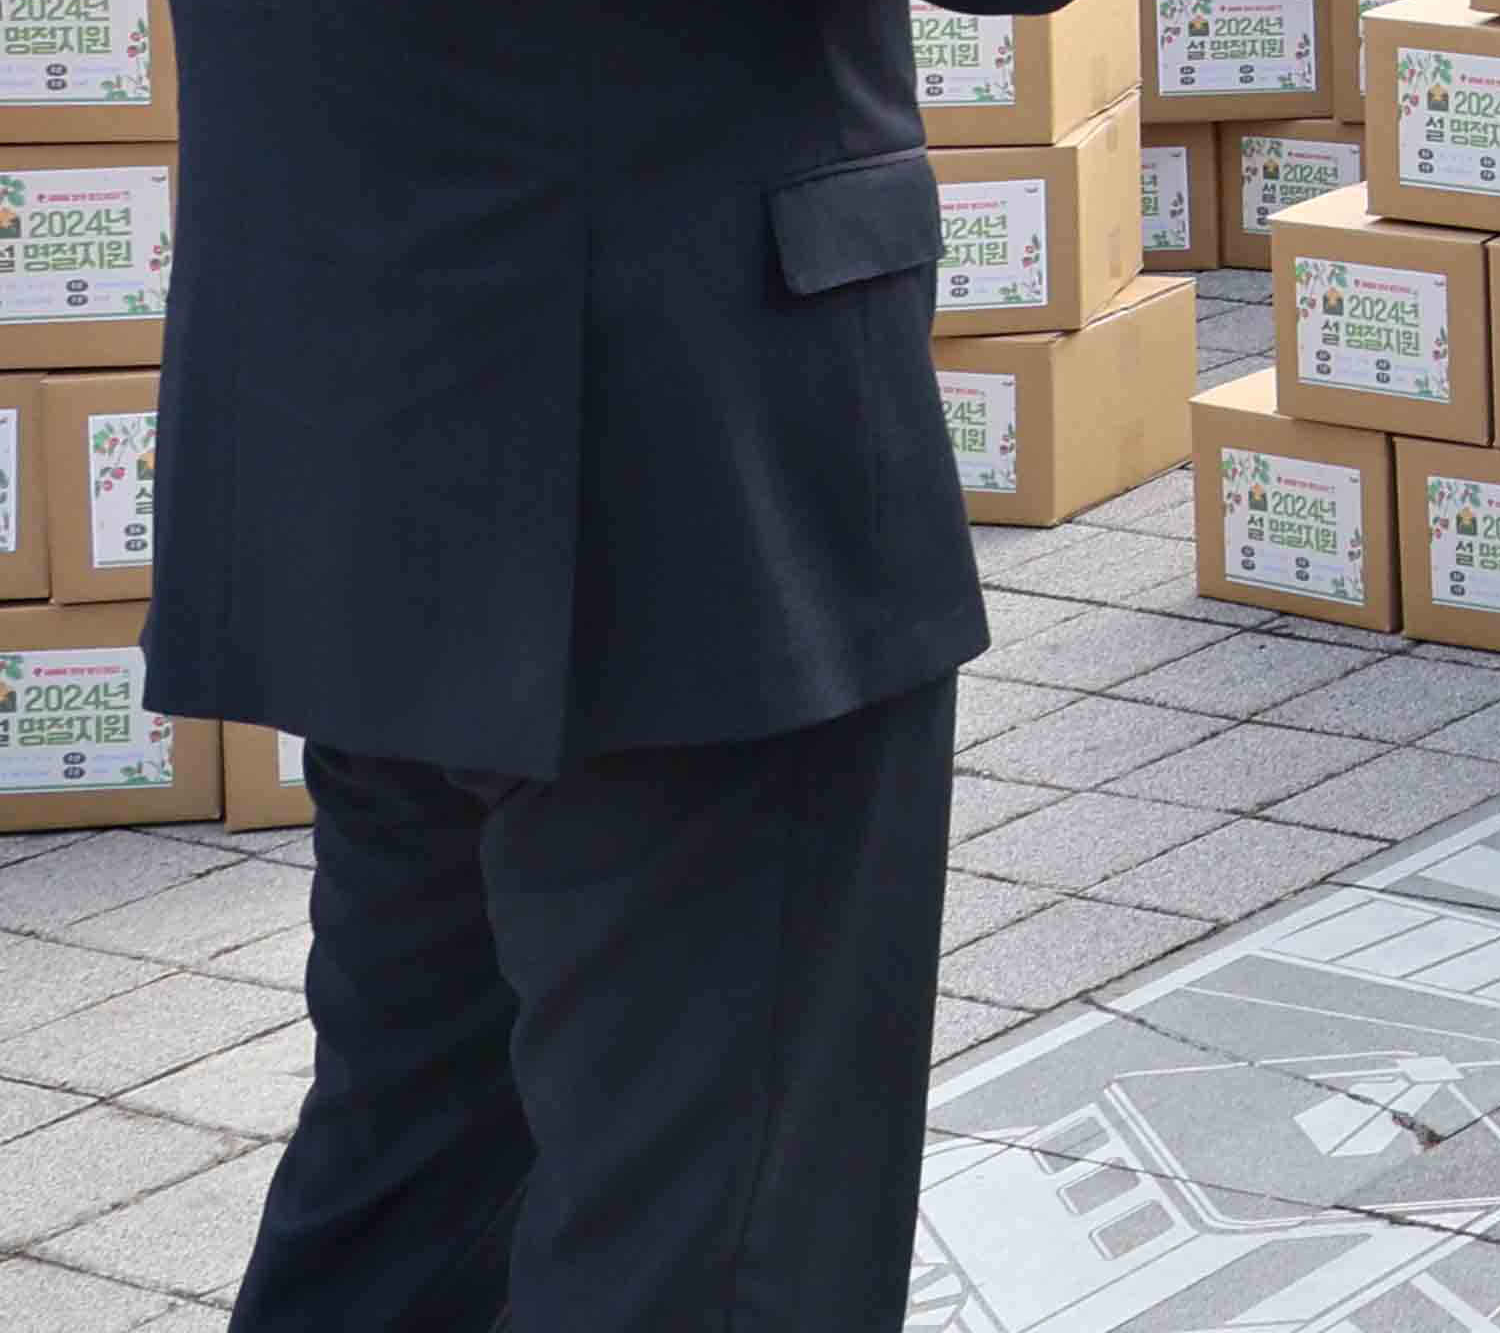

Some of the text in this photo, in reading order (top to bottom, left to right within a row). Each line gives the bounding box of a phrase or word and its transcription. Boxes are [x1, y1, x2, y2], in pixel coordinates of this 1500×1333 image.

[4, 26, 111, 55] 명절지원
[28, 207, 132, 239] 2024년
[23, 240, 132, 272] 명절지원
[24, 682, 130, 712] 2024년
[18, 714, 130, 746] 명절지원
